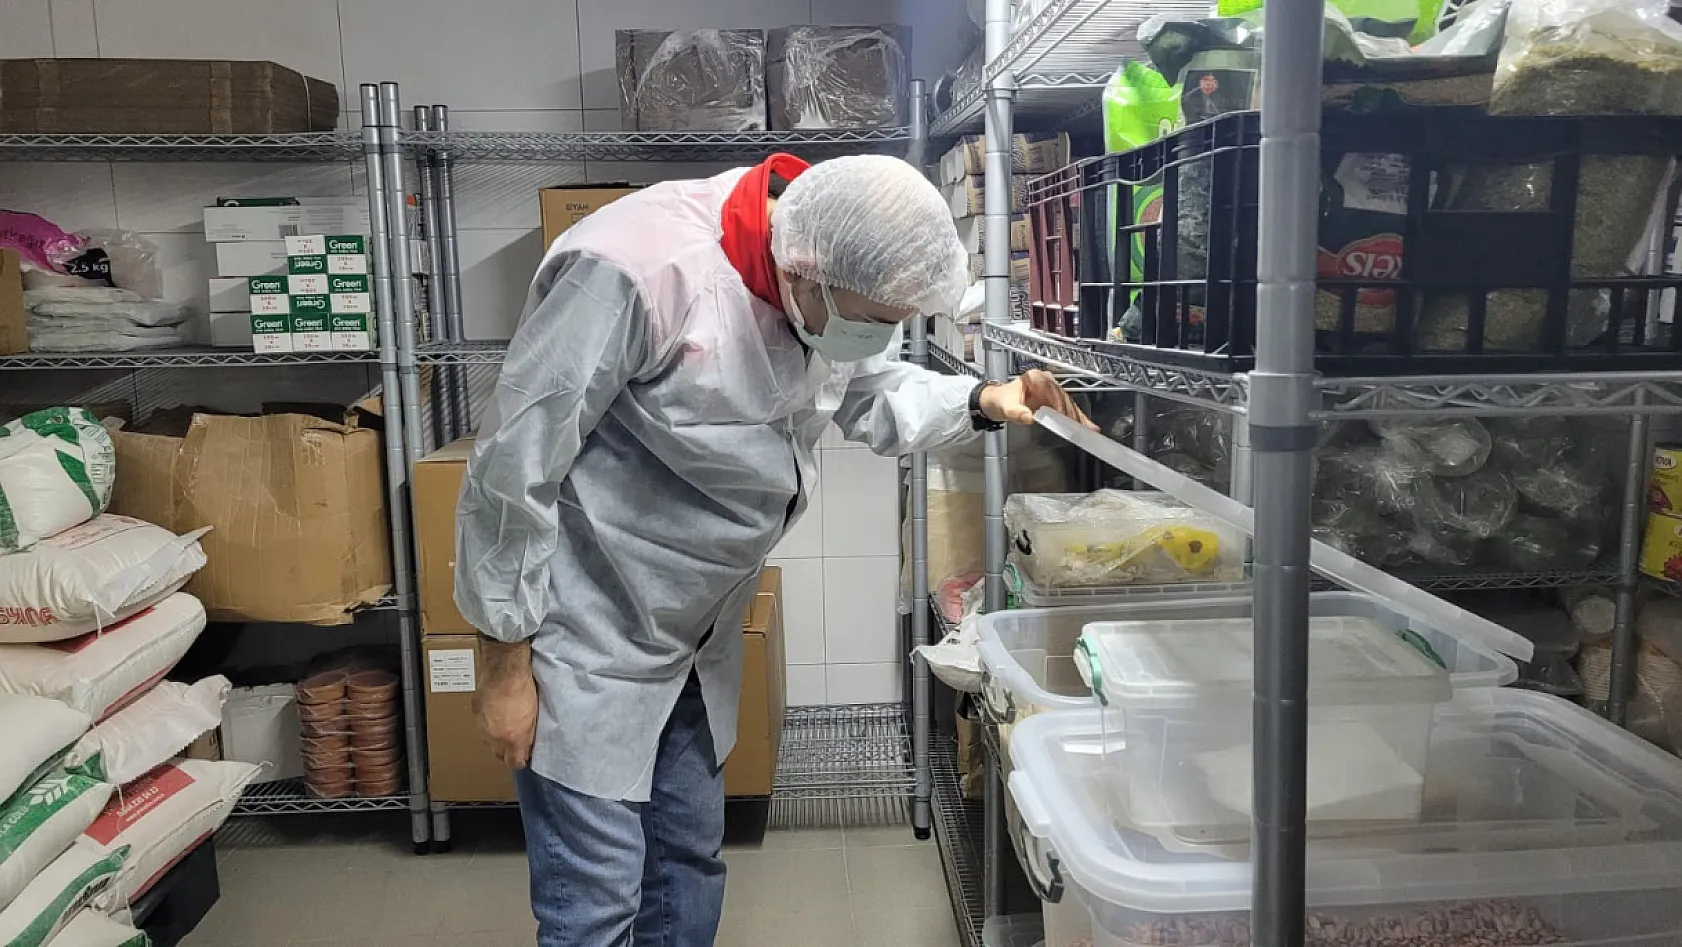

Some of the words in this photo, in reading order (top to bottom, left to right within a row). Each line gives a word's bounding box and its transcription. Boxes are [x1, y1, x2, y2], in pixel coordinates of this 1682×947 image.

[329, 240, 358, 250] Green
[92, 264, 108, 274] kg
[294, 260, 323, 270] Green
[251, 279, 280, 290] Green
[333, 279, 362, 289] Green
[254, 319, 283, 329] Green
[295, 318, 323, 328] Green
[332, 317, 361, 327] Green
